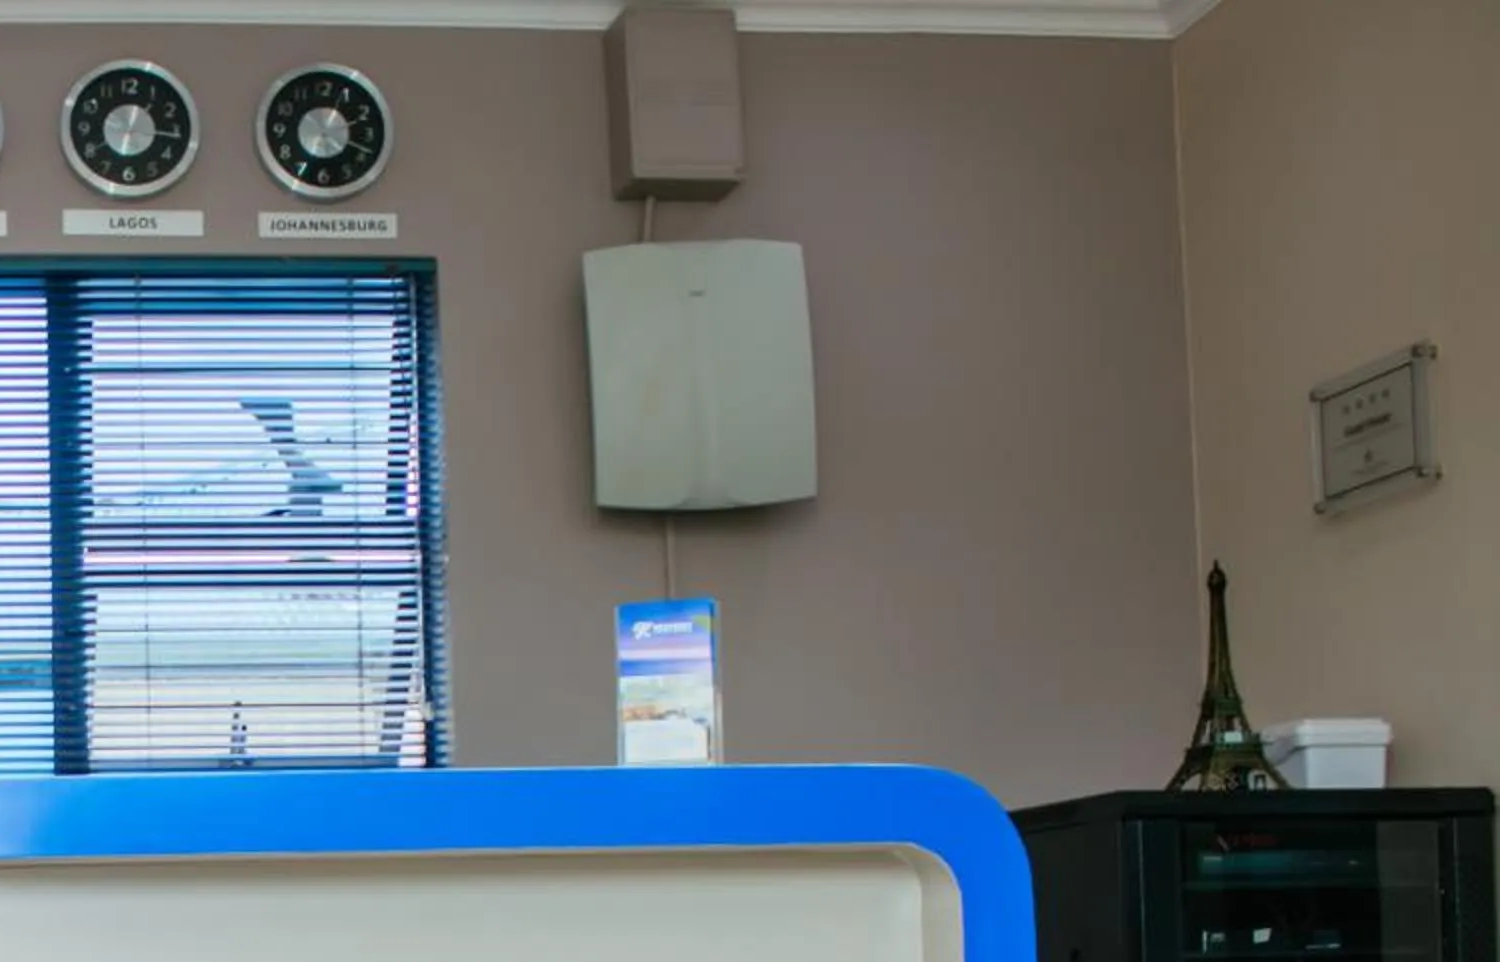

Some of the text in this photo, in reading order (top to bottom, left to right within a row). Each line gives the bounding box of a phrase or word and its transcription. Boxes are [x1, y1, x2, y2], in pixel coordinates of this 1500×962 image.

[101, 84, 113, 98] 11
[122, 78, 138, 95] 12
[164, 101, 177, 118] 2
[358, 104, 370, 121] 2
[78, 121, 90, 137] 9
[273, 122, 286, 138] 9
[365, 127, 374, 142] 3
[84, 142, 96, 159] 8
[280, 143, 291, 160] 8
[102, 161, 112, 175] 7
[122, 165, 136, 182] 6
[147, 161, 158, 177] 5
[295, 161, 307, 176] 7
[318, 168, 330, 184] 6
[108, 216, 158, 230] LAGOS
[270, 219, 388, 232] JOHANNESBURG
